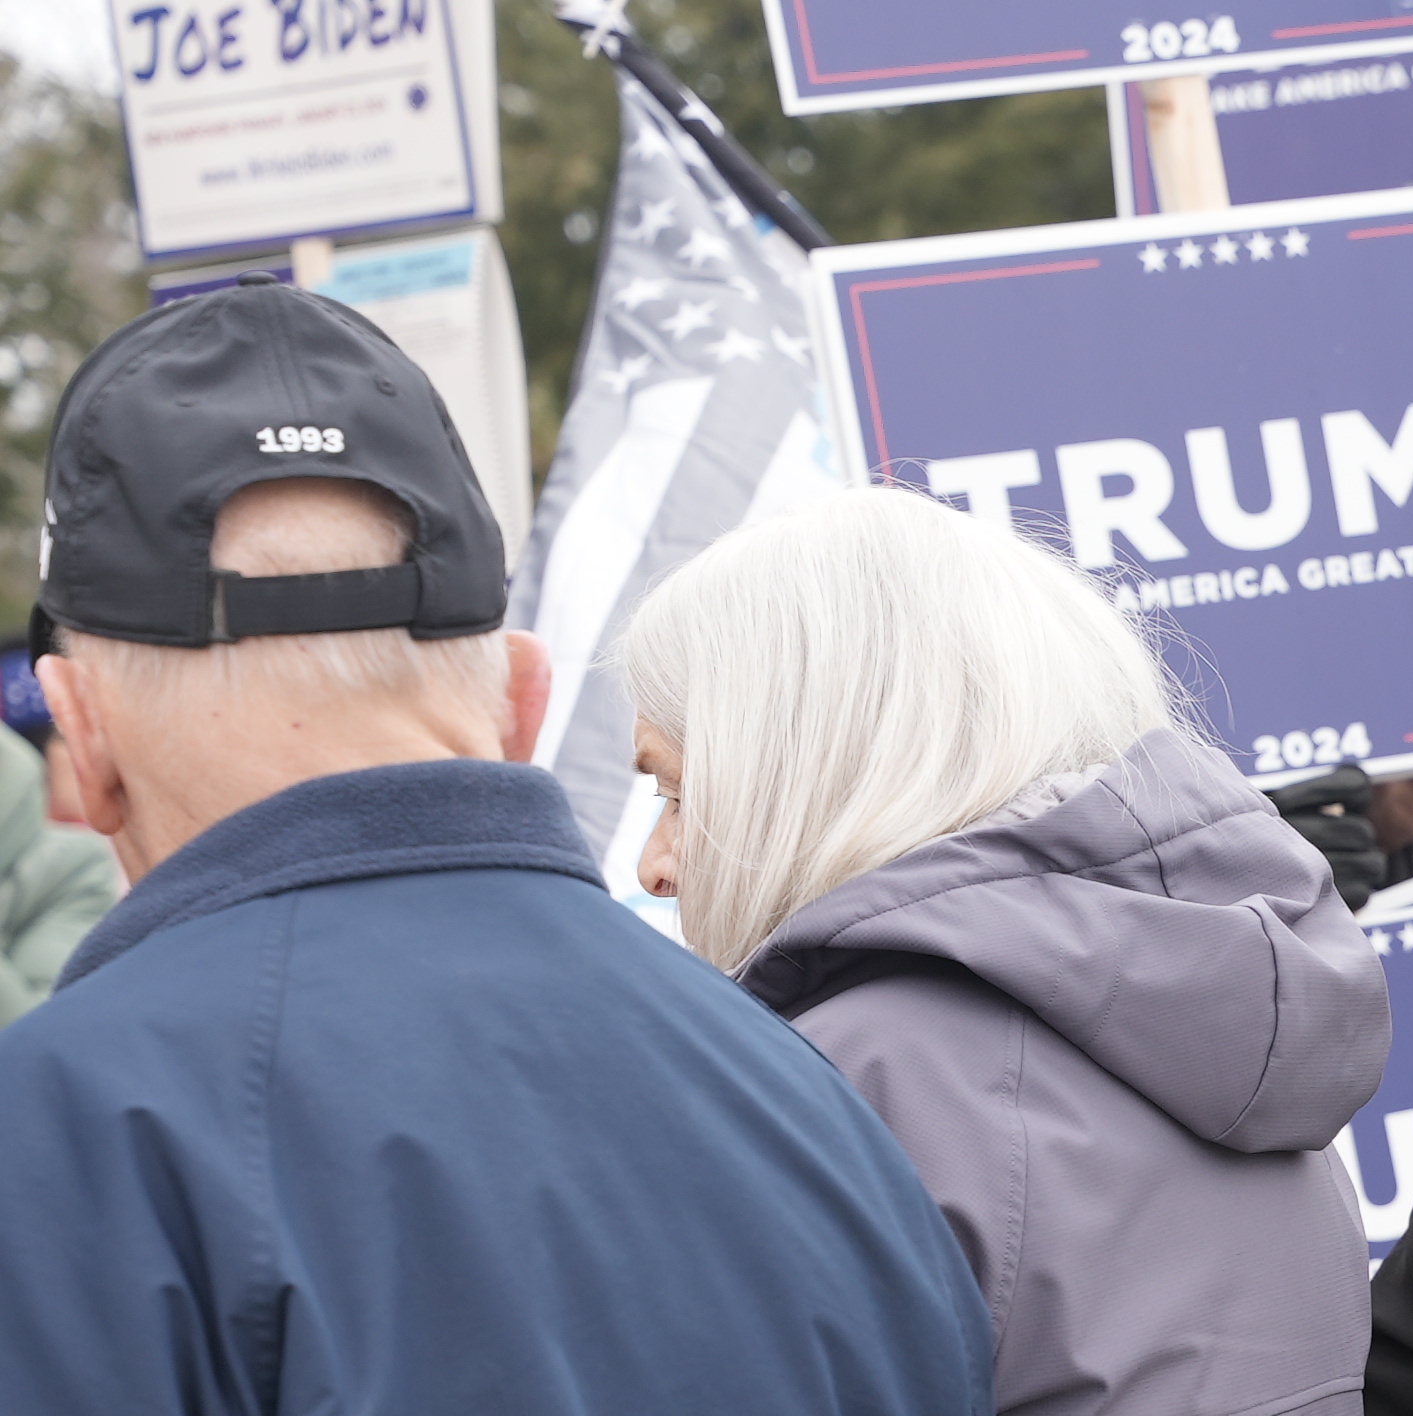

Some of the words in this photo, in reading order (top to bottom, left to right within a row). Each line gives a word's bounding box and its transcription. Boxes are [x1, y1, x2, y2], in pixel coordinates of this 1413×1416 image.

[131, 6, 244, 81] JOE
[1120, 16, 1240, 63] 2024
[1274, 62, 1410, 106] AMERICA
[256, 426, 345, 453] 1993
[1114, 563, 1289, 613] AMERICA
[1254, 722, 1374, 773] 2024
